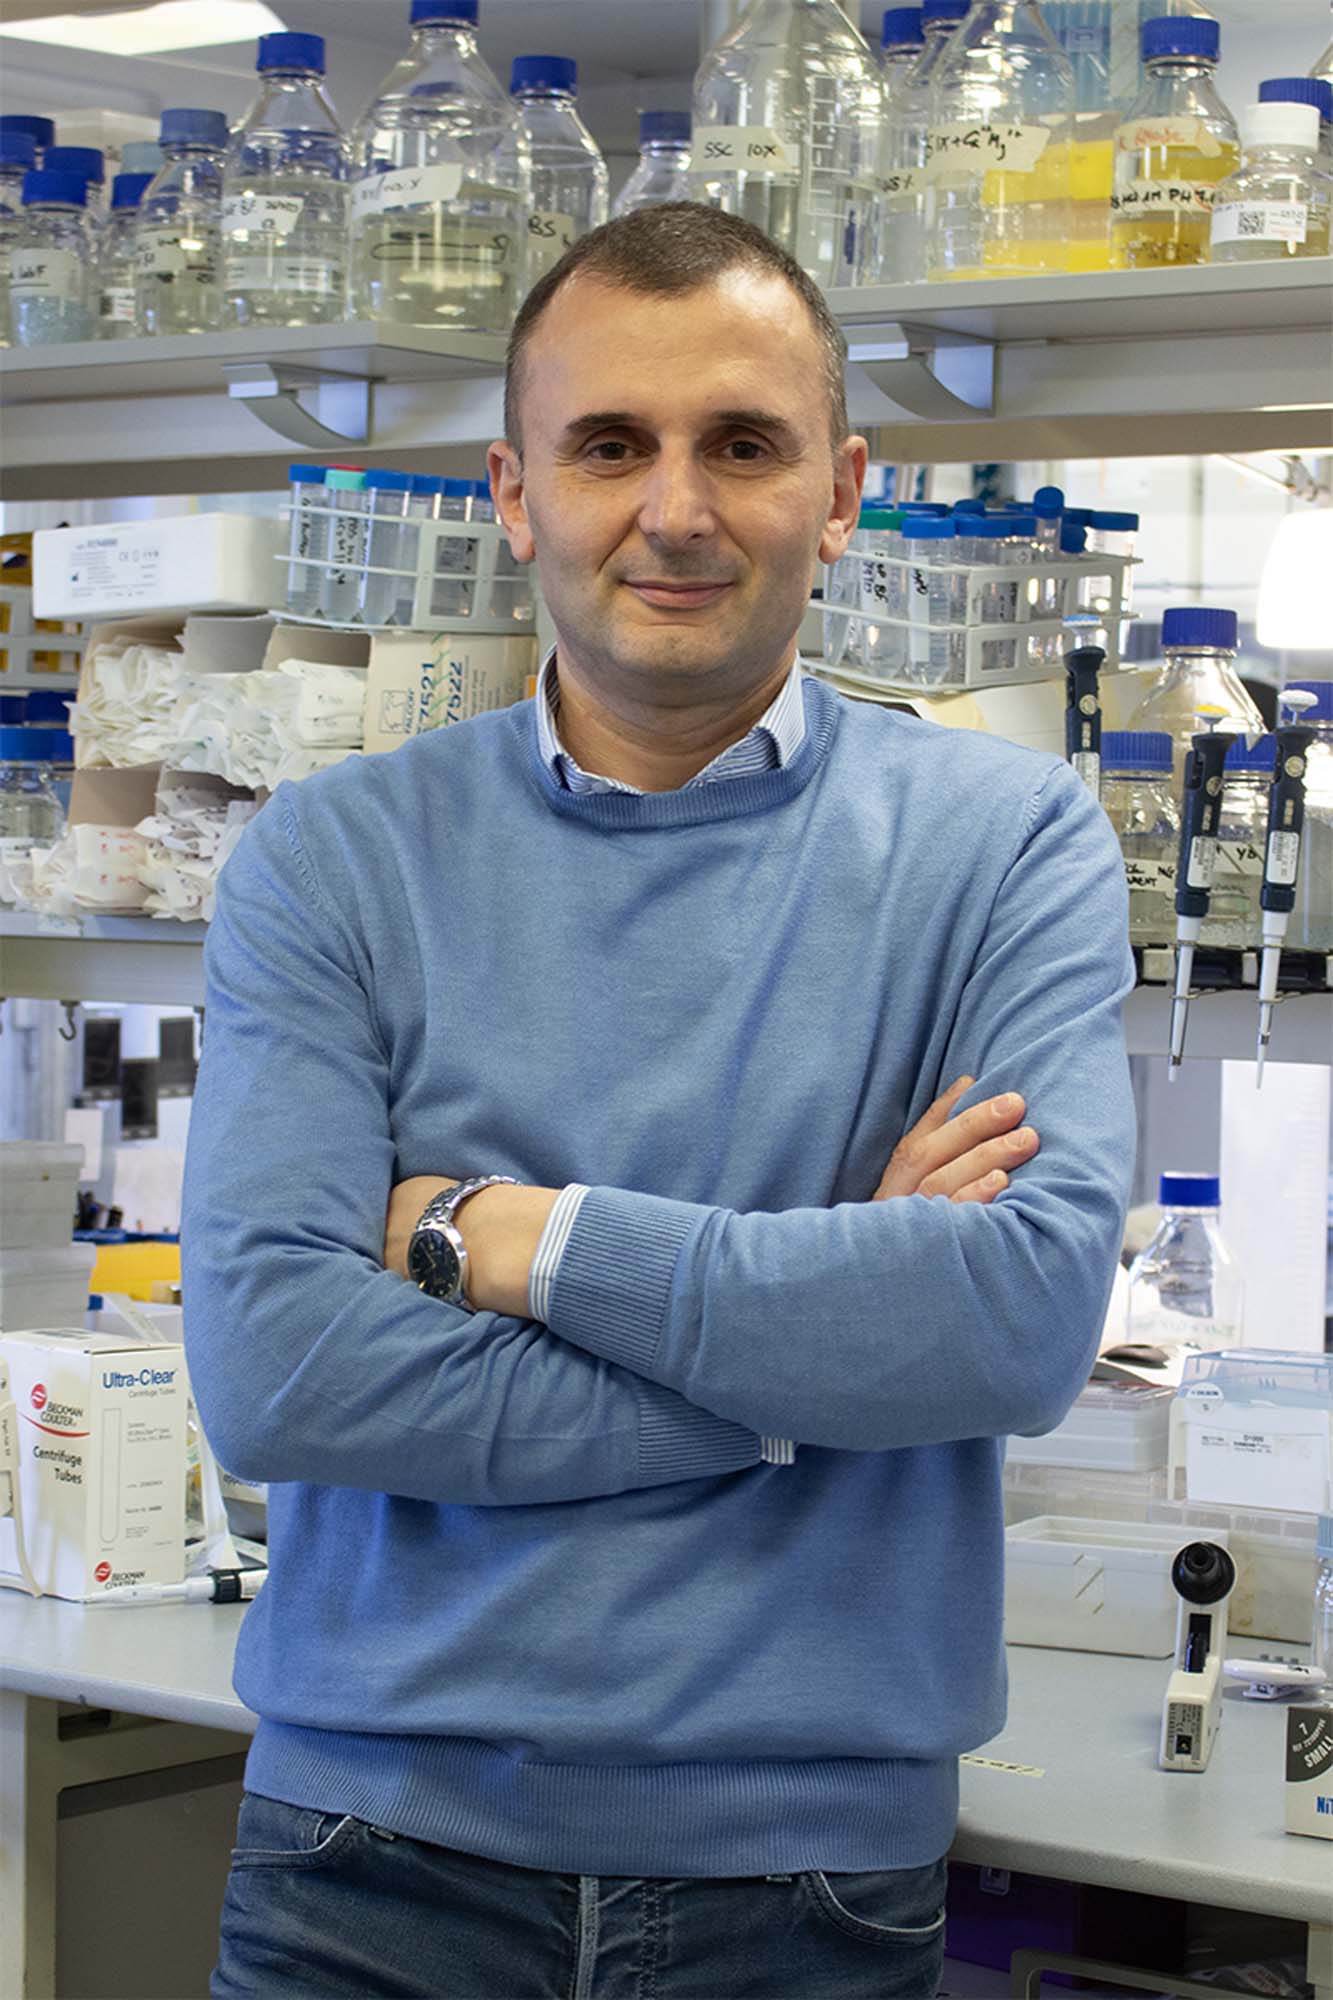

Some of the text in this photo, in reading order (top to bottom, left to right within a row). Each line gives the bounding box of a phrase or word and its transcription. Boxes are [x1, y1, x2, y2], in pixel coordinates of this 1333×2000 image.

[704, 141, 733, 159] SSC
[103, 1369, 176, 1389] Ultra-Clear
[47, 1401, 83, 1417] BECKMAN
[41, 1411, 74, 1427] COULTER
[33, 1445, 82, 1468] Centrifuge
[55, 1468, 83, 1485] Tubes
[1304, 1735, 1333, 1769] SMALL
